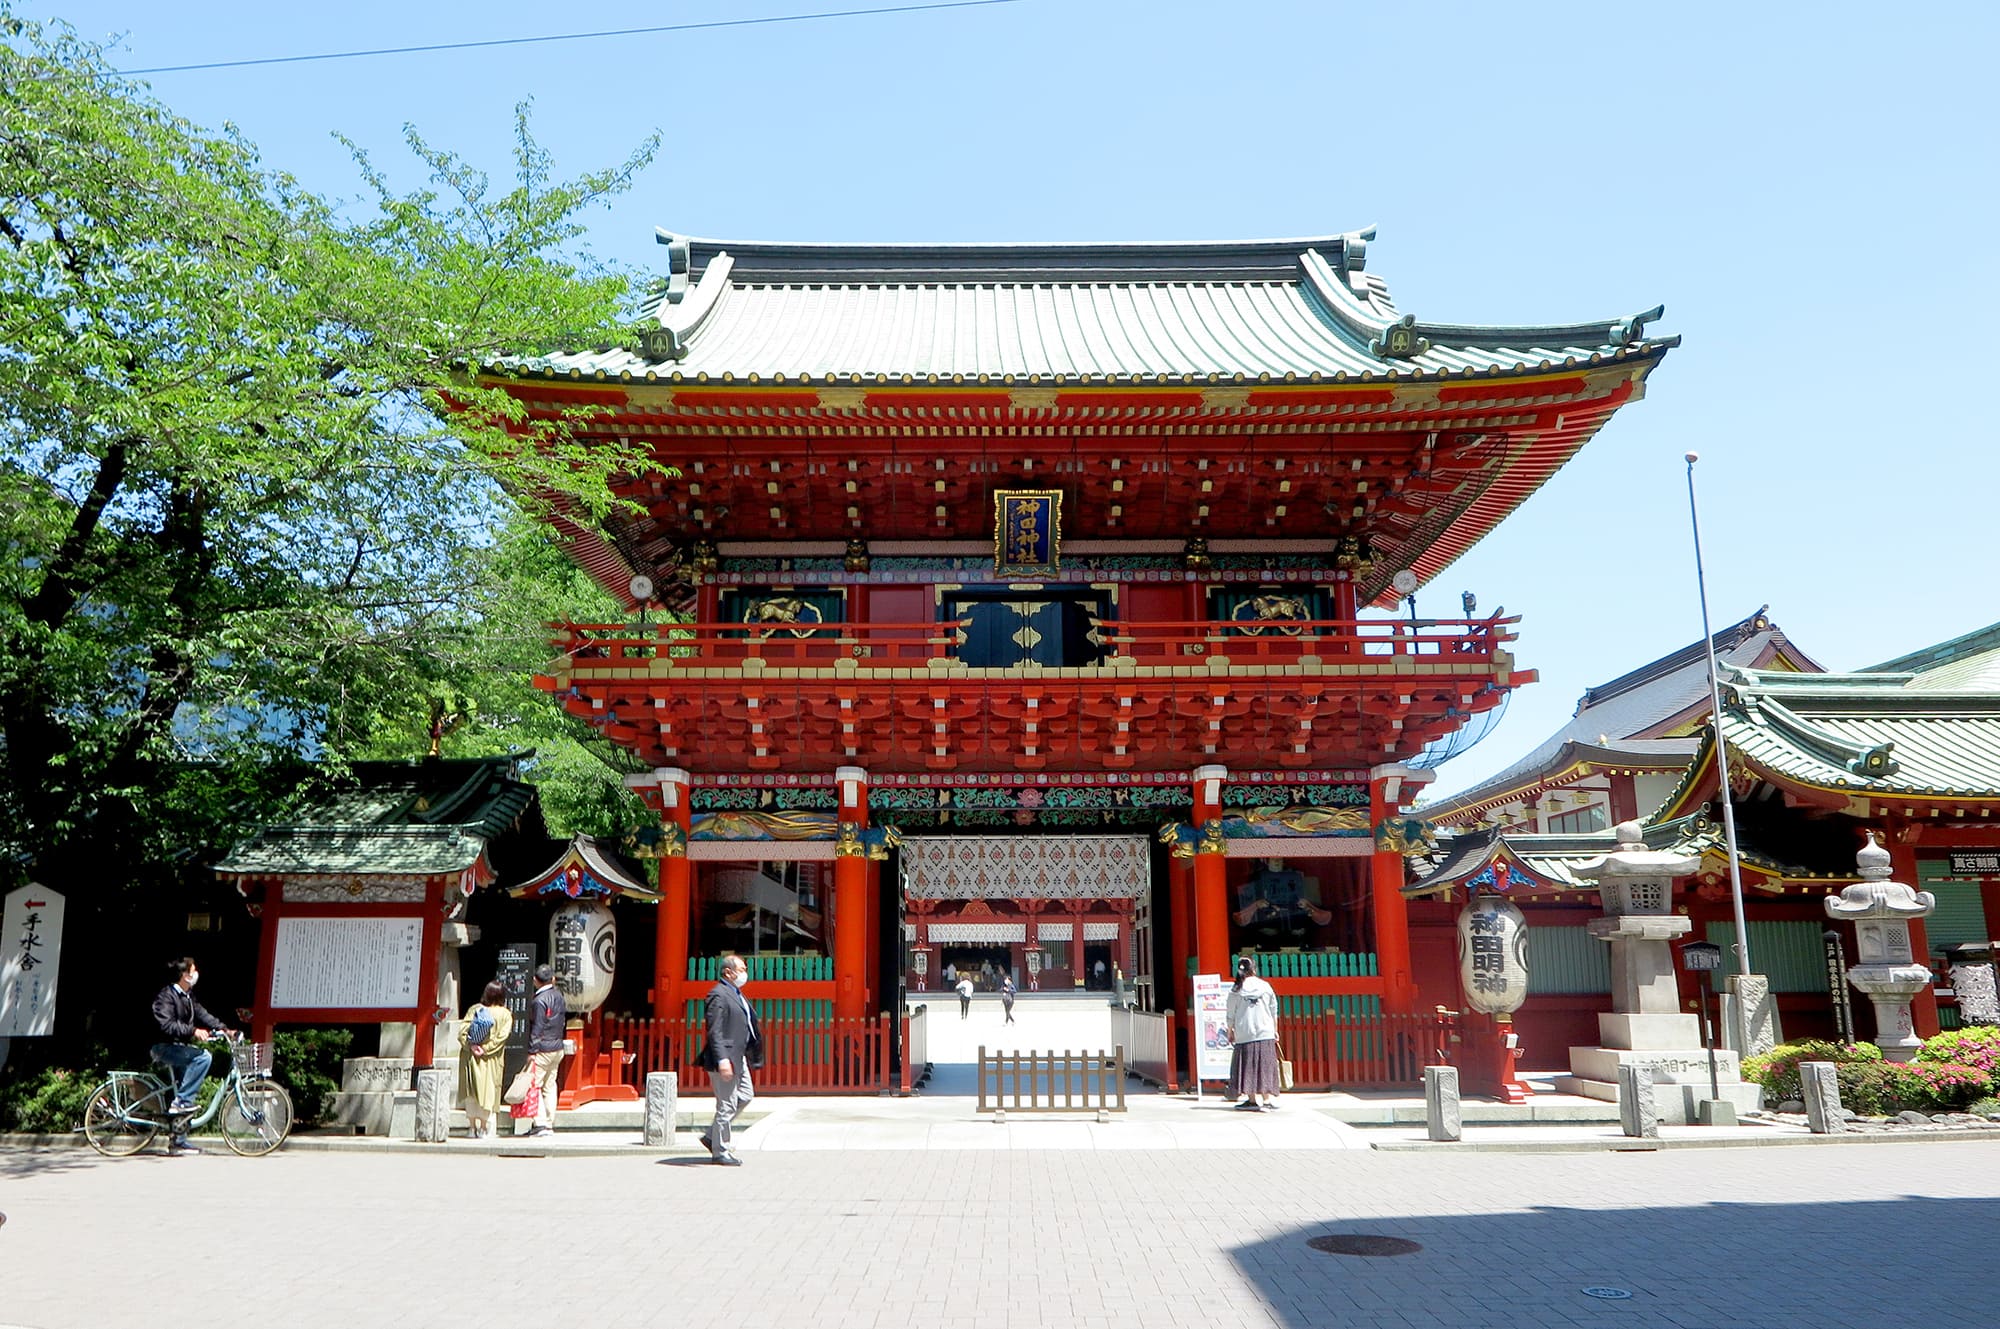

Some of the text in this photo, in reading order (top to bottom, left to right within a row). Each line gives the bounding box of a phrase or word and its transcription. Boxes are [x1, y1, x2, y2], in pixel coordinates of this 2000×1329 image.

[1016, 499, 1041, 564] 神田神社
[1953, 857, 2000, 868] 高さ制限
[16, 912, 43, 971] 手水舎
[554, 914, 586, 997] 神田明神
[1469, 912, 1508, 996] 神田明神
